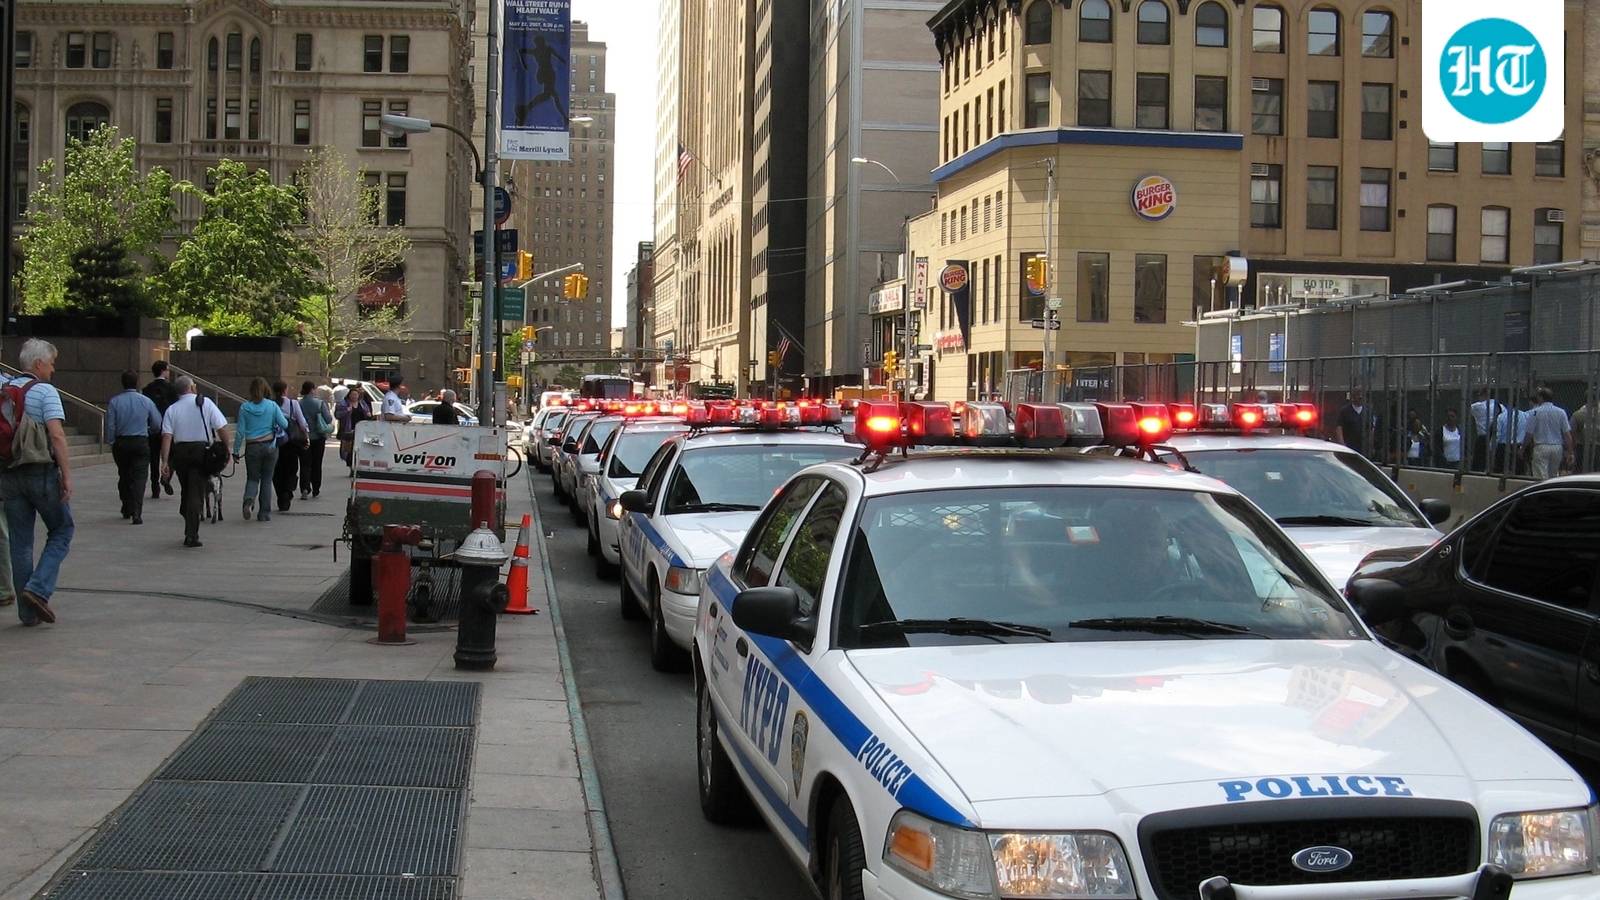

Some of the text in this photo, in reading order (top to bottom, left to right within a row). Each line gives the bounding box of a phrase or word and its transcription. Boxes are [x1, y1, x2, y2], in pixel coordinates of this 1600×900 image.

[1136, 183, 1171, 200] BURGER
[1138, 191, 1173, 211] KING
[917, 263, 925, 302] NAILS
[944, 269, 965, 279] BURGER
[944, 275, 966, 285] KING
[394, 452, 456, 469] verizon
[740, 652, 790, 767] NYPD
[858, 734, 912, 797] POLICE
[1218, 776, 1413, 802] POLICE
[1308, 851, 1339, 866] Ford
